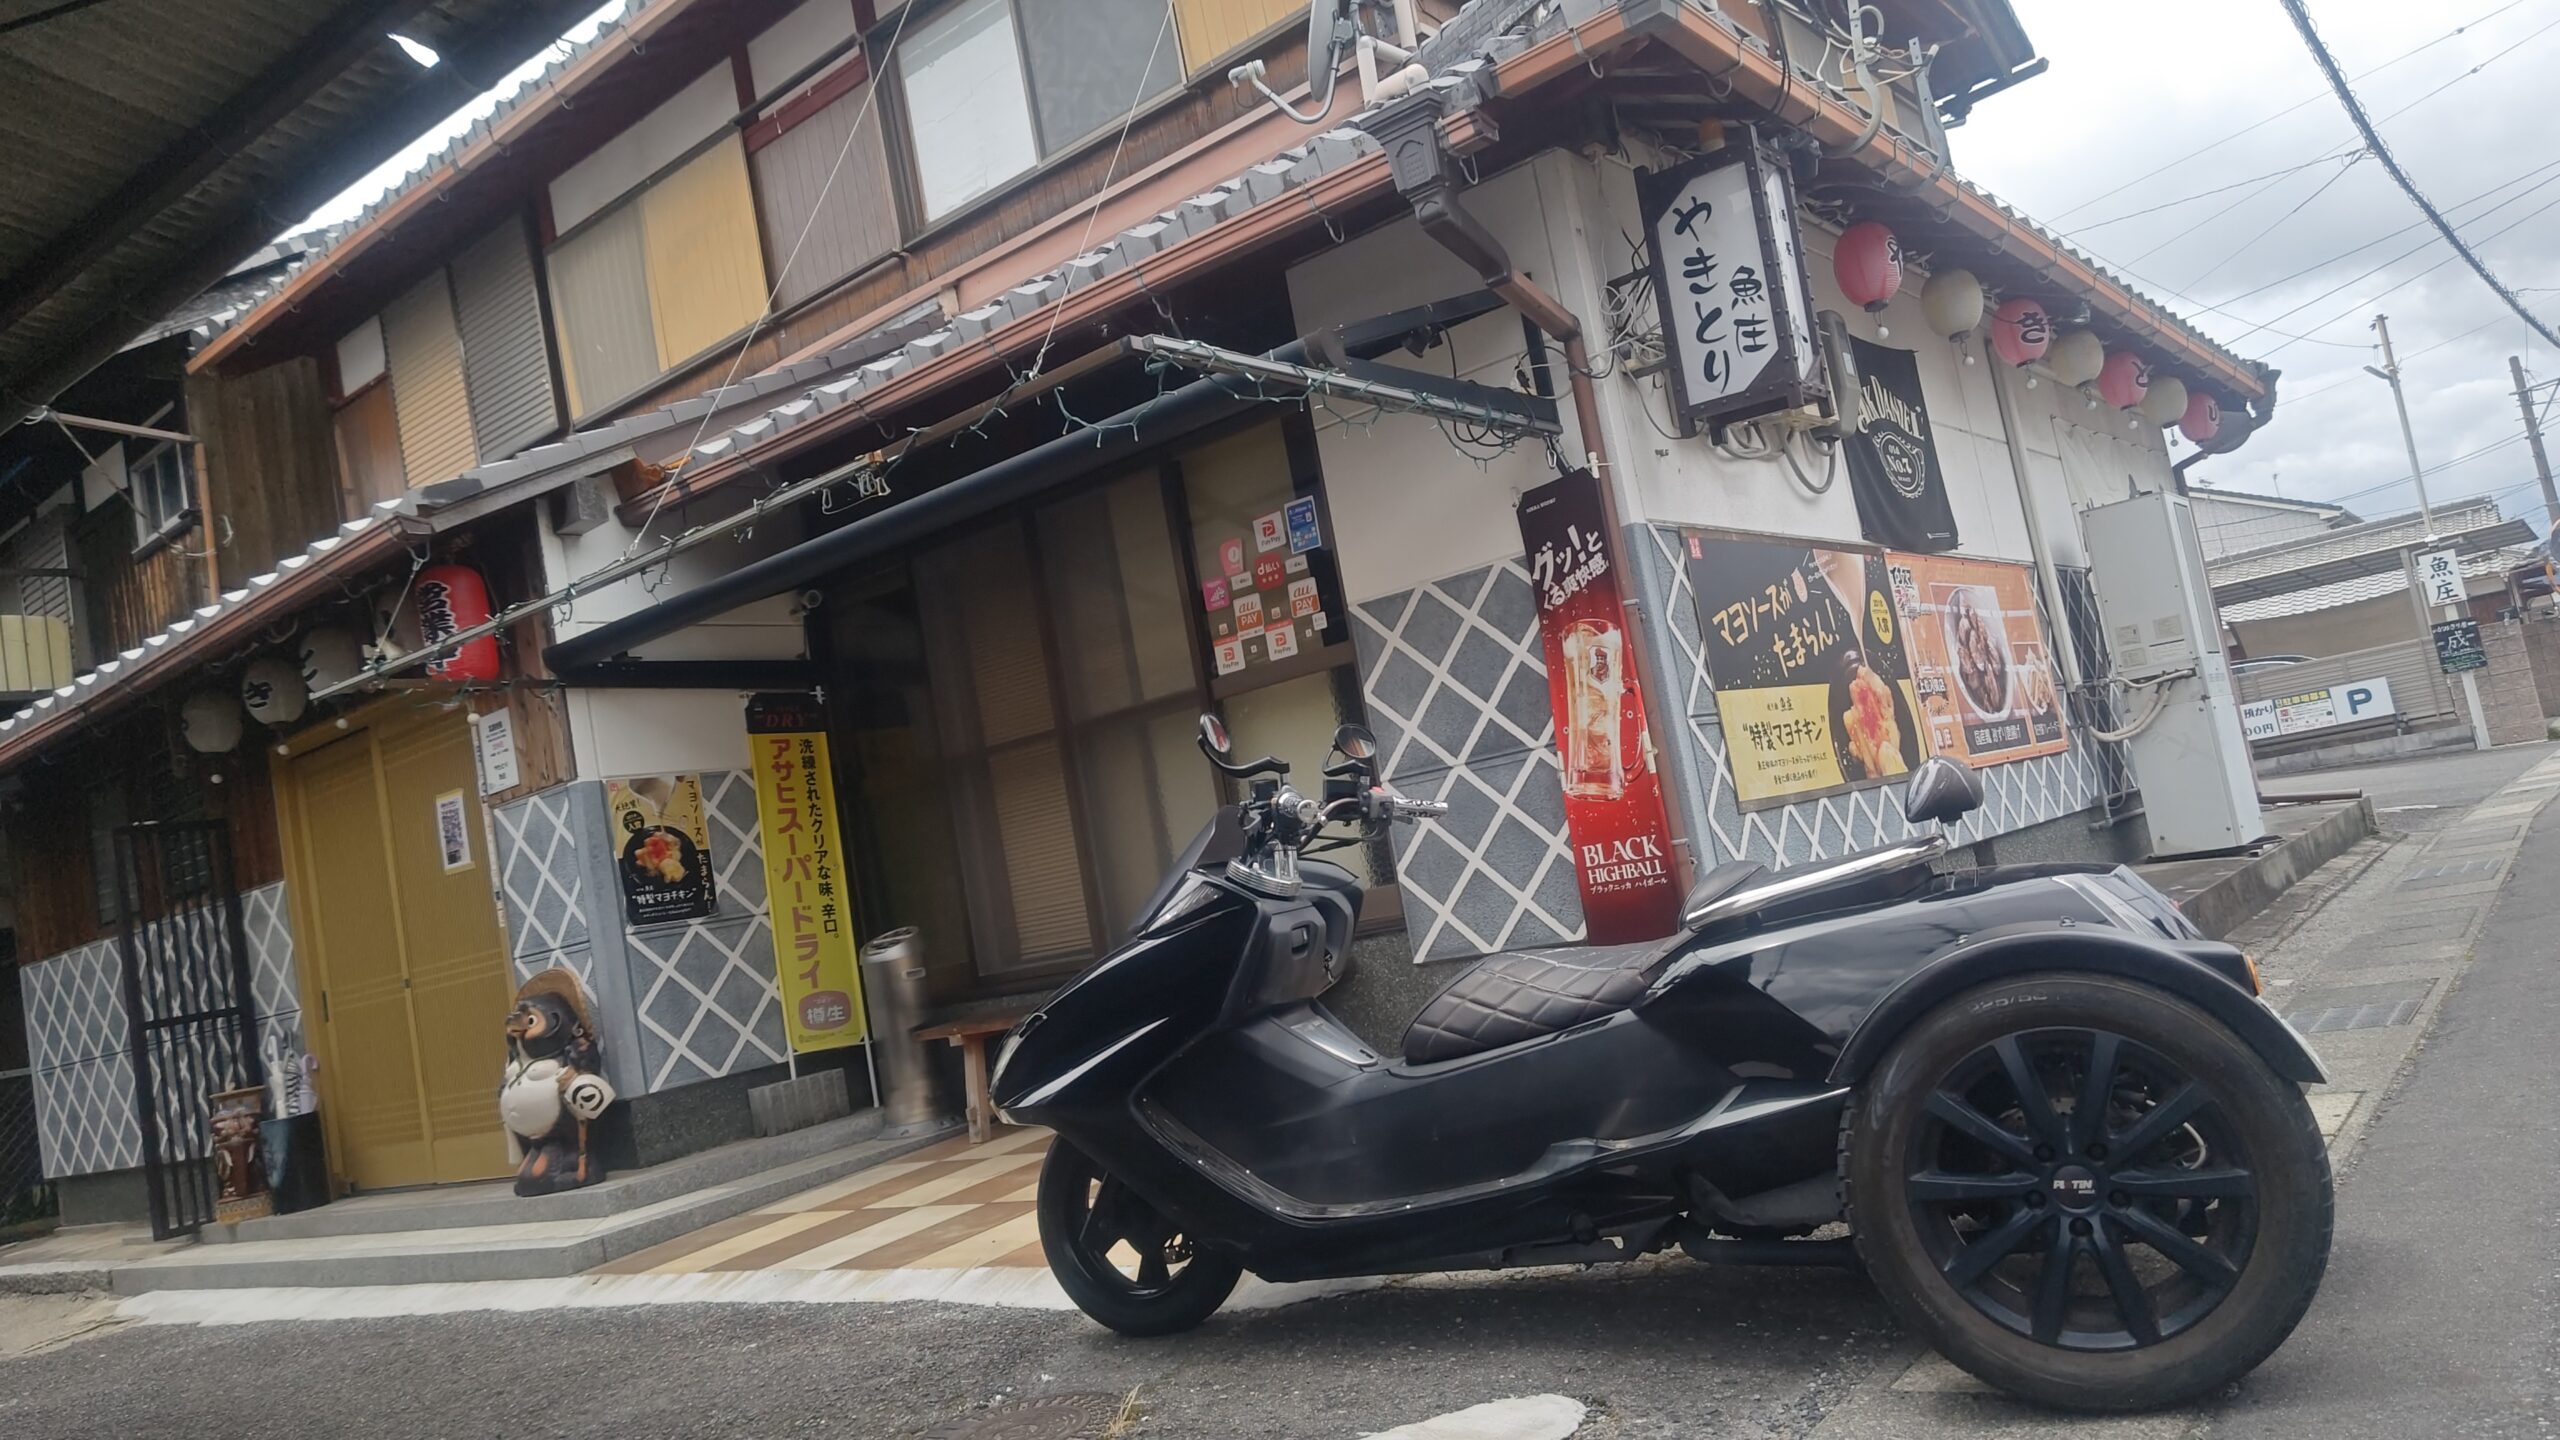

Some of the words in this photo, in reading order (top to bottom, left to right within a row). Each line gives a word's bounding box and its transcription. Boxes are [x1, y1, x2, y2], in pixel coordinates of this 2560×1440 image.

[1672, 196, 1730, 394] やきとり
[1729, 265, 1769, 357] 魚庄
[2016, 311, 2047, 344] き
[1293, 584, 1313, 598] au
[2430, 556, 2459, 601] 魚庄
[1238, 601, 1258, 614] au
[1240, 613, 1258, 626] PAY
[1295, 597, 1313, 610] PAY
[1712, 577, 1792, 647] マヨソースが
[1773, 598, 1840, 679] たまらん!
[2346, 688, 2373, 716] P
[686, 780, 704, 846] マヨソースが
[798, 739, 840, 939] 洗練されたクリアな味、辛口。
[1582, 834, 1663, 868] BLACK
[769, 738, 819, 989] アサヒスーパードライ
[1587, 859, 1667, 885] HIGHBALL
[1590, 882, 1632, 895] ブラックニッカ
[1634, 878, 1669, 889] ハイボール
[806, 1005, 847, 1025] 樽生
